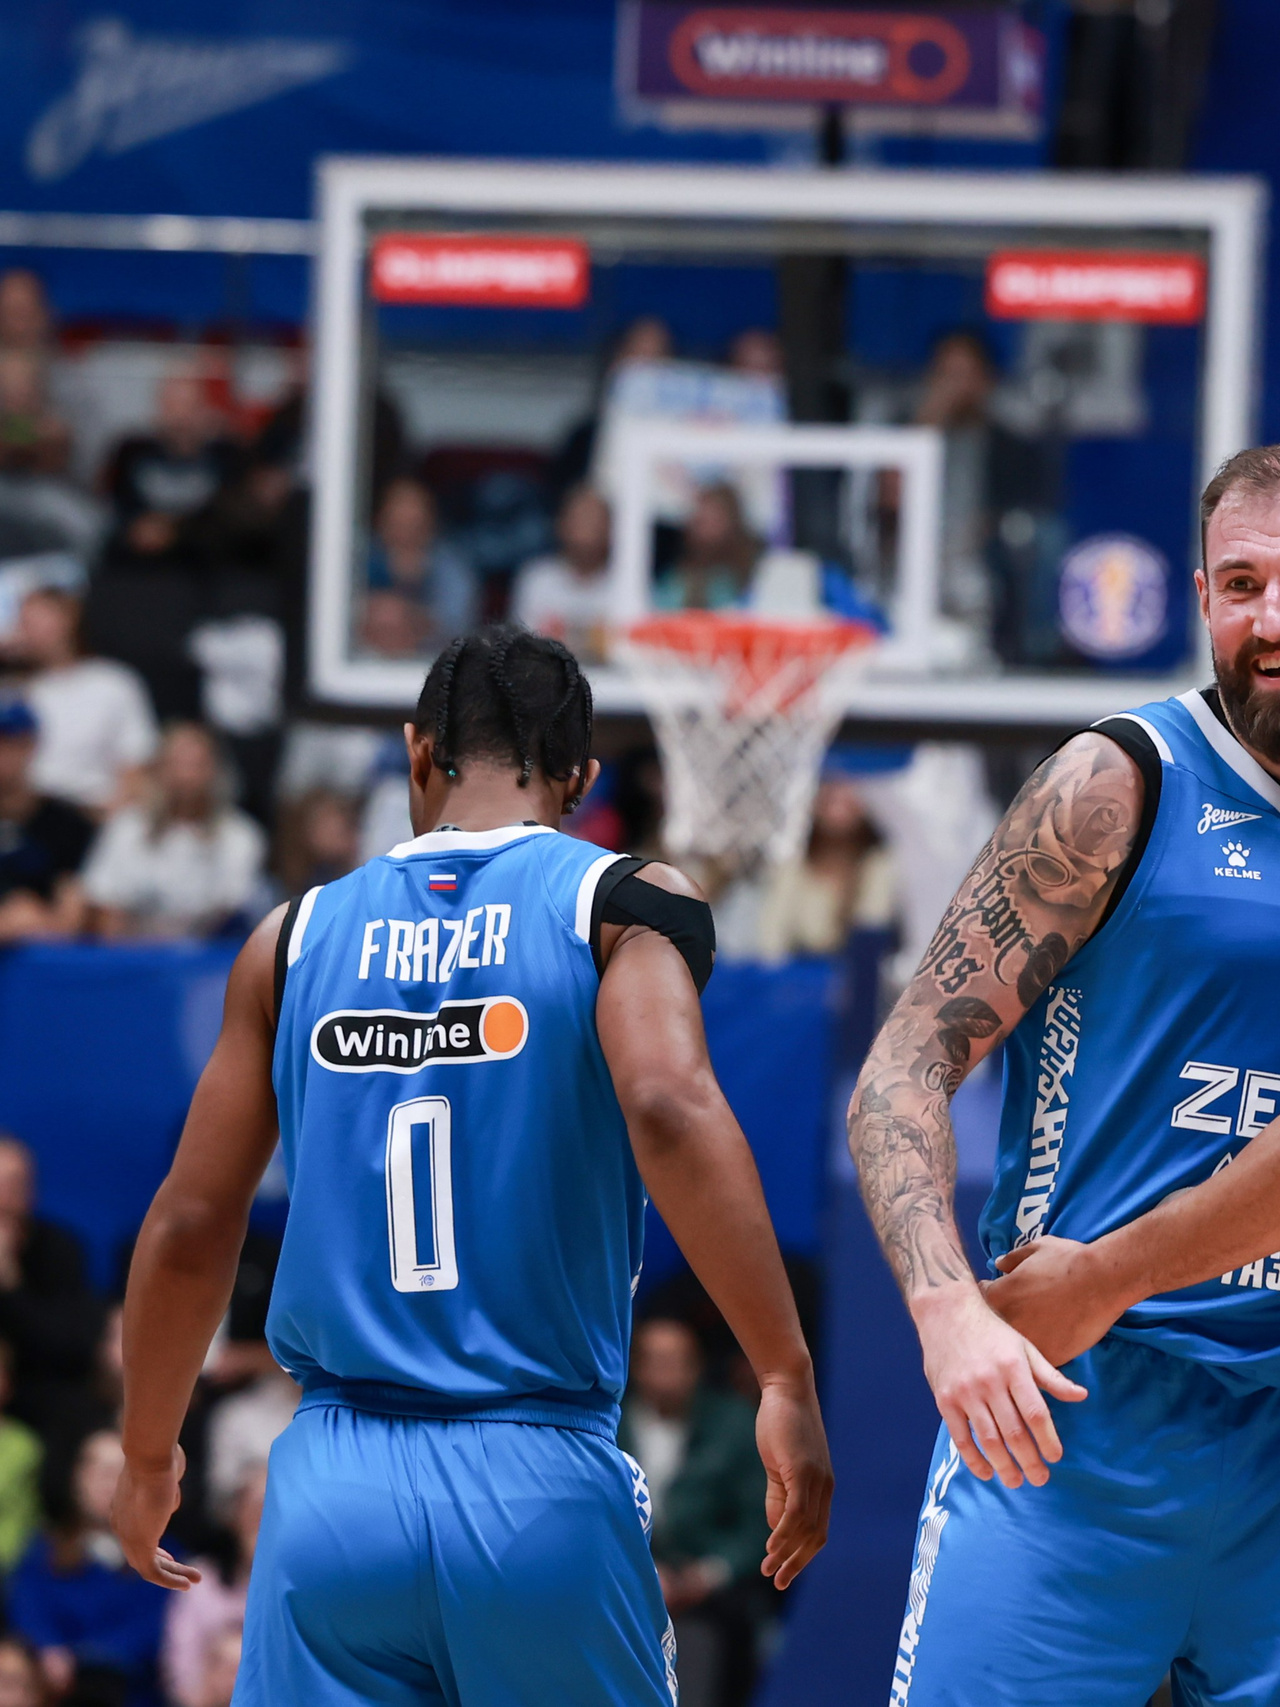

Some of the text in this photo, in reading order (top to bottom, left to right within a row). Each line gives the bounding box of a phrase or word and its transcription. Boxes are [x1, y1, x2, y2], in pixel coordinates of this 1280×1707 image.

[695, 30, 888, 85] Winline
[1214, 867, 1262, 880] KELME
[333, 1021, 471, 1059] Winline
[385, 1095, 460, 1293] 0
